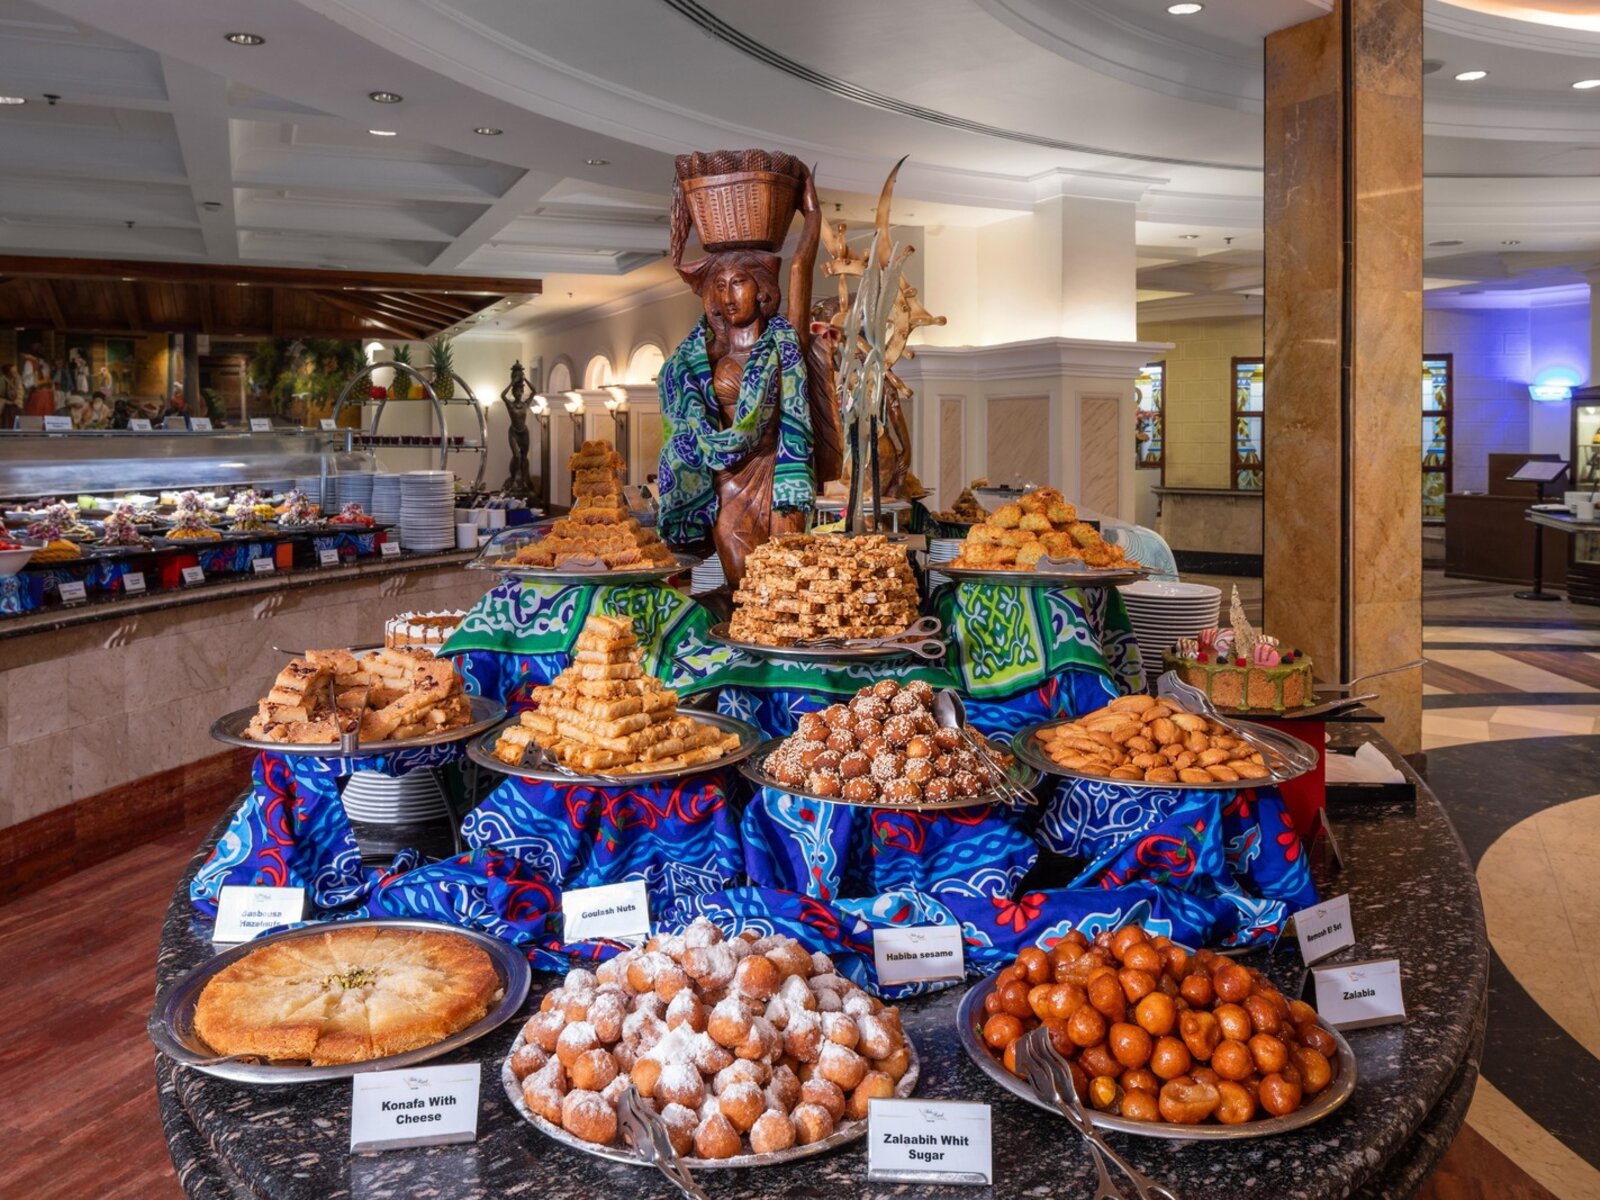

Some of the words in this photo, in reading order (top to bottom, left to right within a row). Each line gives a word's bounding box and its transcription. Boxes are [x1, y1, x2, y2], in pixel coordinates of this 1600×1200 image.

[581, 907, 615, 919] Goulash
[616, 904, 636, 913] Nuts
[886, 952, 918, 961] Habiba
[919, 950, 953, 959] sesame
[1343, 988, 1376, 1000] Zalabia
[381, 1098, 425, 1111] Konafa
[429, 1095, 457, 1107] With
[396, 1112, 442, 1125] Cheese
[883, 1133, 937, 1145] Zalaabih
[940, 1135, 969, 1146] Whit
[908, 1149, 945, 1163] Sugar
